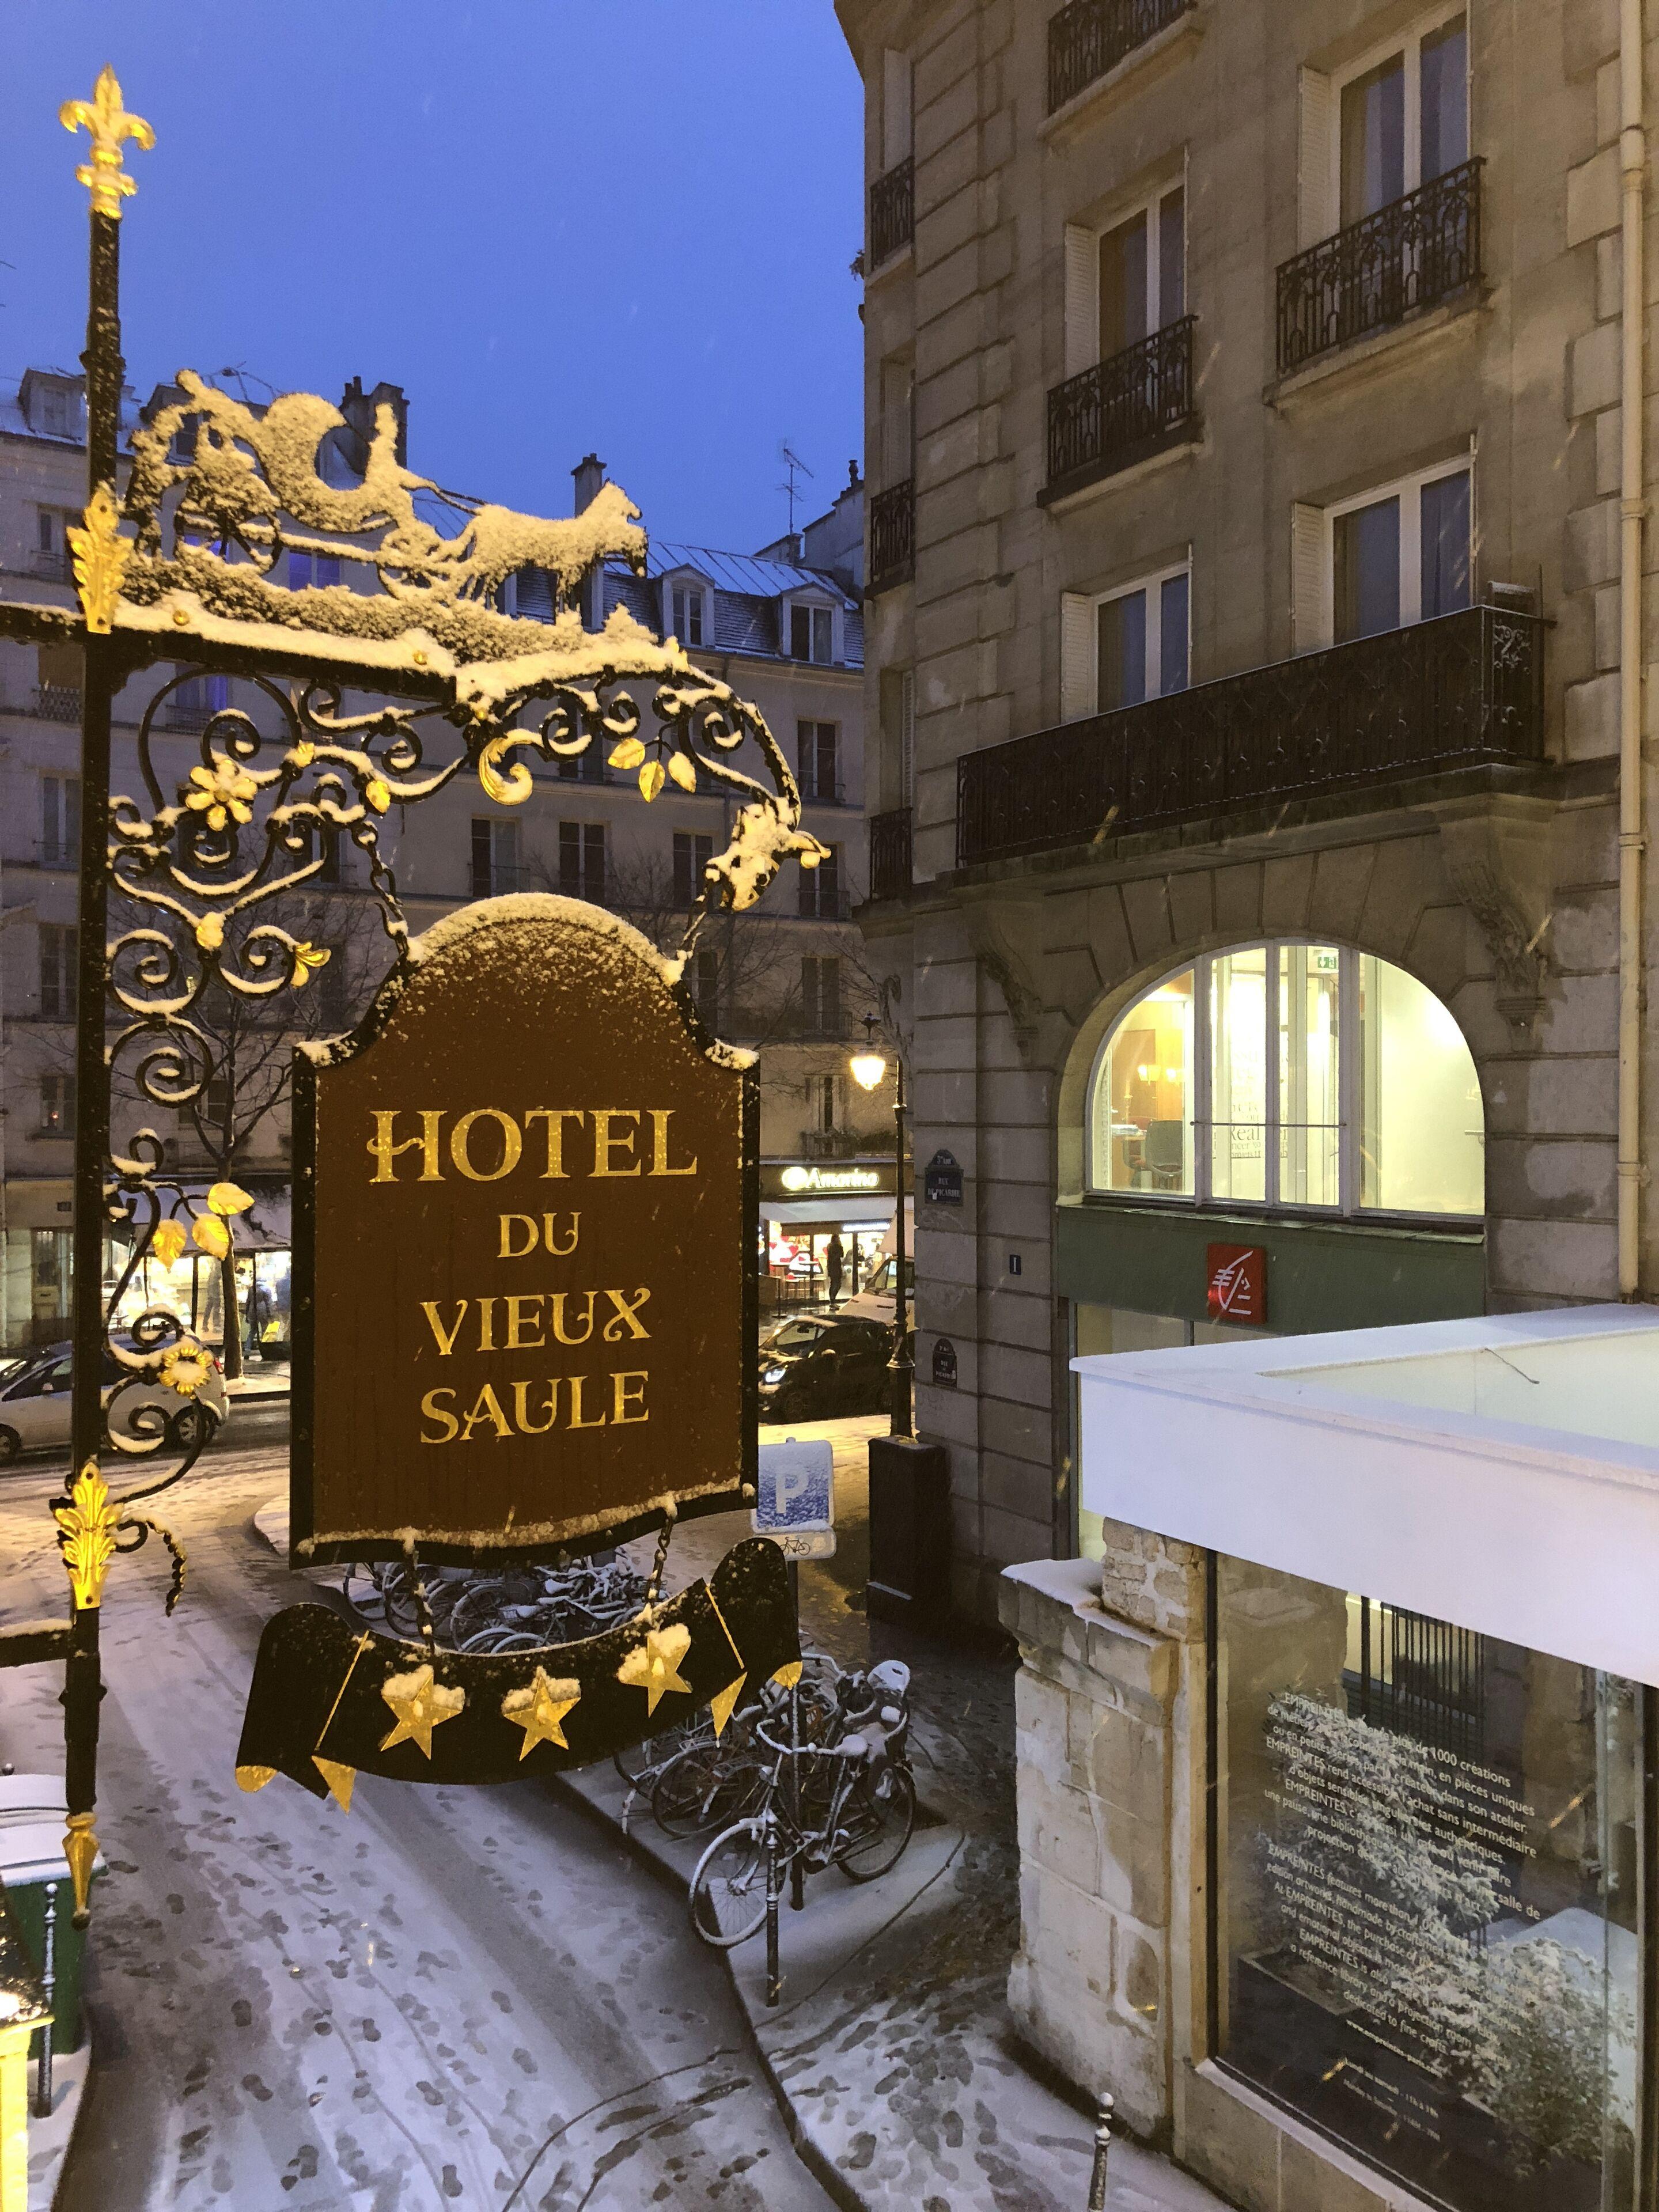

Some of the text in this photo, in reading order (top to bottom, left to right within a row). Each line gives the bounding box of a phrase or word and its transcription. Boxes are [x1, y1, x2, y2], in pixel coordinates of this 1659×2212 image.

[367, 1108, 697, 1183] HOTEL
[808, 1168, 880, 1188] Amorino
[497, 1211, 582, 1258] DU
[419, 1287, 652, 1356] VIEUX
[420, 1370, 649, 1444] SAULE
[776, 1465, 809, 1514] P
[1266, 1736, 1325, 1771] EMPREINTES
[1328, 1762, 1349, 1780] rend
[1437, 1808, 1459, 1825] sans
[1463, 1817, 1536, 1859] intermédiaire
[1273, 1724, 1284, 1736] ou
[1286, 1729, 1297, 1742] en
[1442, 1789, 1464, 1809] dans
[1468, 1802, 1487, 1818] son
[1491, 1809, 1527, 1835] atelier.
[1439, 1770, 1451, 1785] en
[1455, 1775, 1487, 1801] pièces
[1492, 1789, 1535, 1820] uniques
[1460, 1757, 1510, 1788] créations
[1265, 1788, 1279, 1802] une
[1498, 1891, 1522, 1912] salle
[1525, 1903, 1539, 1921] de
[1281, 1901, 1296, 1919] and
[1298, 1910, 1340, 1942] emotional
[1336, 1893, 1382, 1927] handmade
[1387, 1919, 1395, 1937] by
[1365, 1892, 1387, 1911] more
[1389, 1902, 1410, 1922] than
[1300, 1927, 1358, 1969] EMPREINTES
[1370, 1965, 1388, 1986] also
[1347, 1918, 1361, 1935] the
[1364, 1927, 1404, 1959] purchase
[1299, 1945, 1337, 1978] reference
[1340, 1967, 1367, 1995] library
[1398, 1998, 1443, 2036] projection
[1344, 1987, 1387, 2021] dedicated
[1388, 2013, 1397, 2027] to
[1400, 2018, 1416, 2040] fine
